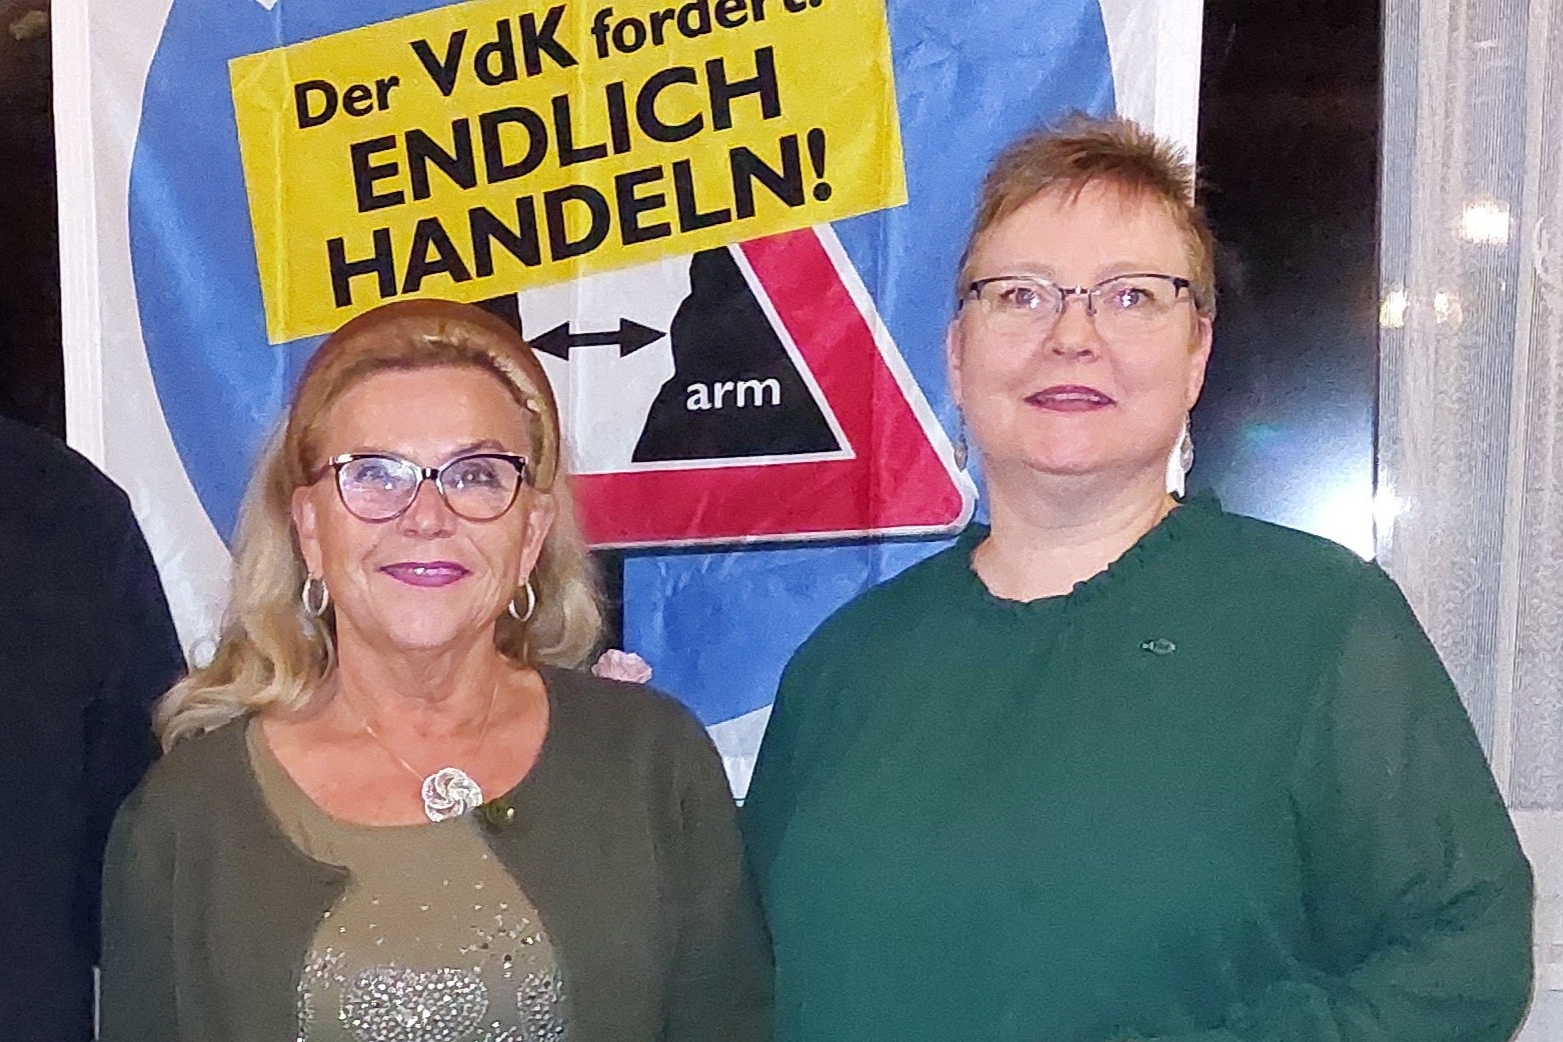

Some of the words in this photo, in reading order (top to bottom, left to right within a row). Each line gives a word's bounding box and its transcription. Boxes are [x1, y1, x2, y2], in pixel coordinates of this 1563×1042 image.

[293, 70, 399, 129] Der
[410, 3, 579, 97] VdK
[349, 46, 782, 212] ENDLICH
[325, 127, 833, 308] HANDELN!
[685, 376, 781, 411] arm
